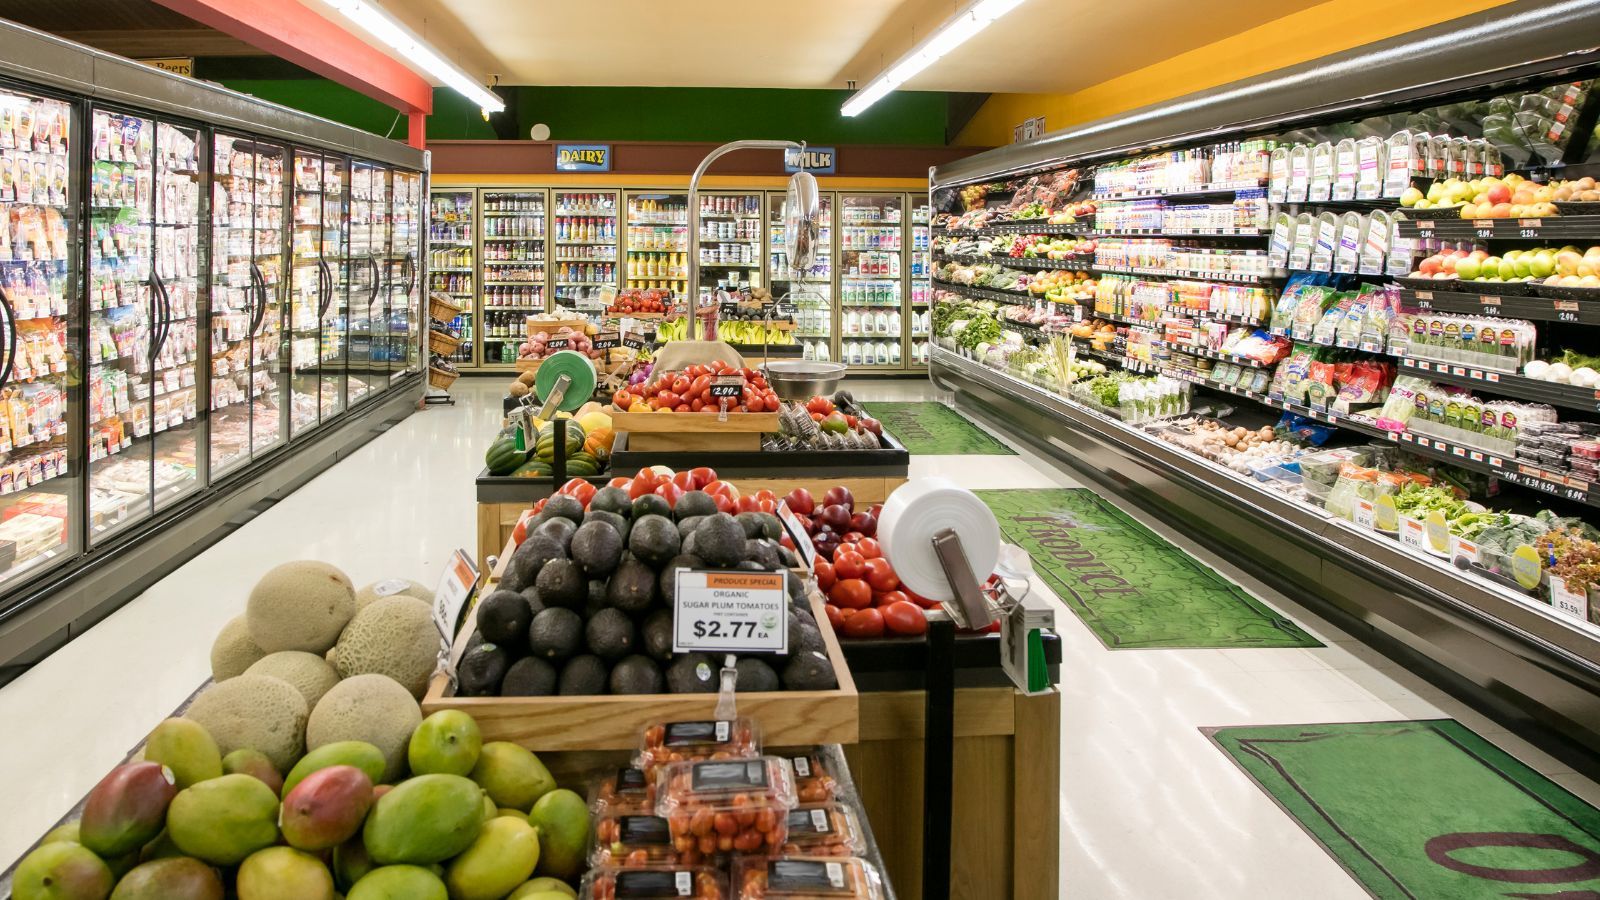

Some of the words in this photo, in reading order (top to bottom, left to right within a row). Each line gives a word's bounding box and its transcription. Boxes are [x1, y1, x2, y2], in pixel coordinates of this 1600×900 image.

[559, 148, 606, 165] DAIRY
[787, 151, 832, 169] MILK
[1013, 510, 1145, 600] PRODUCE
[713, 577, 748, 586] PRODUCE
[749, 578, 778, 586] SPECIAL
[713, 590, 750, 599] ORGANIC
[682, 601, 710, 609] SUGAR
[711, 601, 735, 610] PLUM
[735, 602, 780, 611] TOMATOES
[692, 619, 758, 640] $2.77
